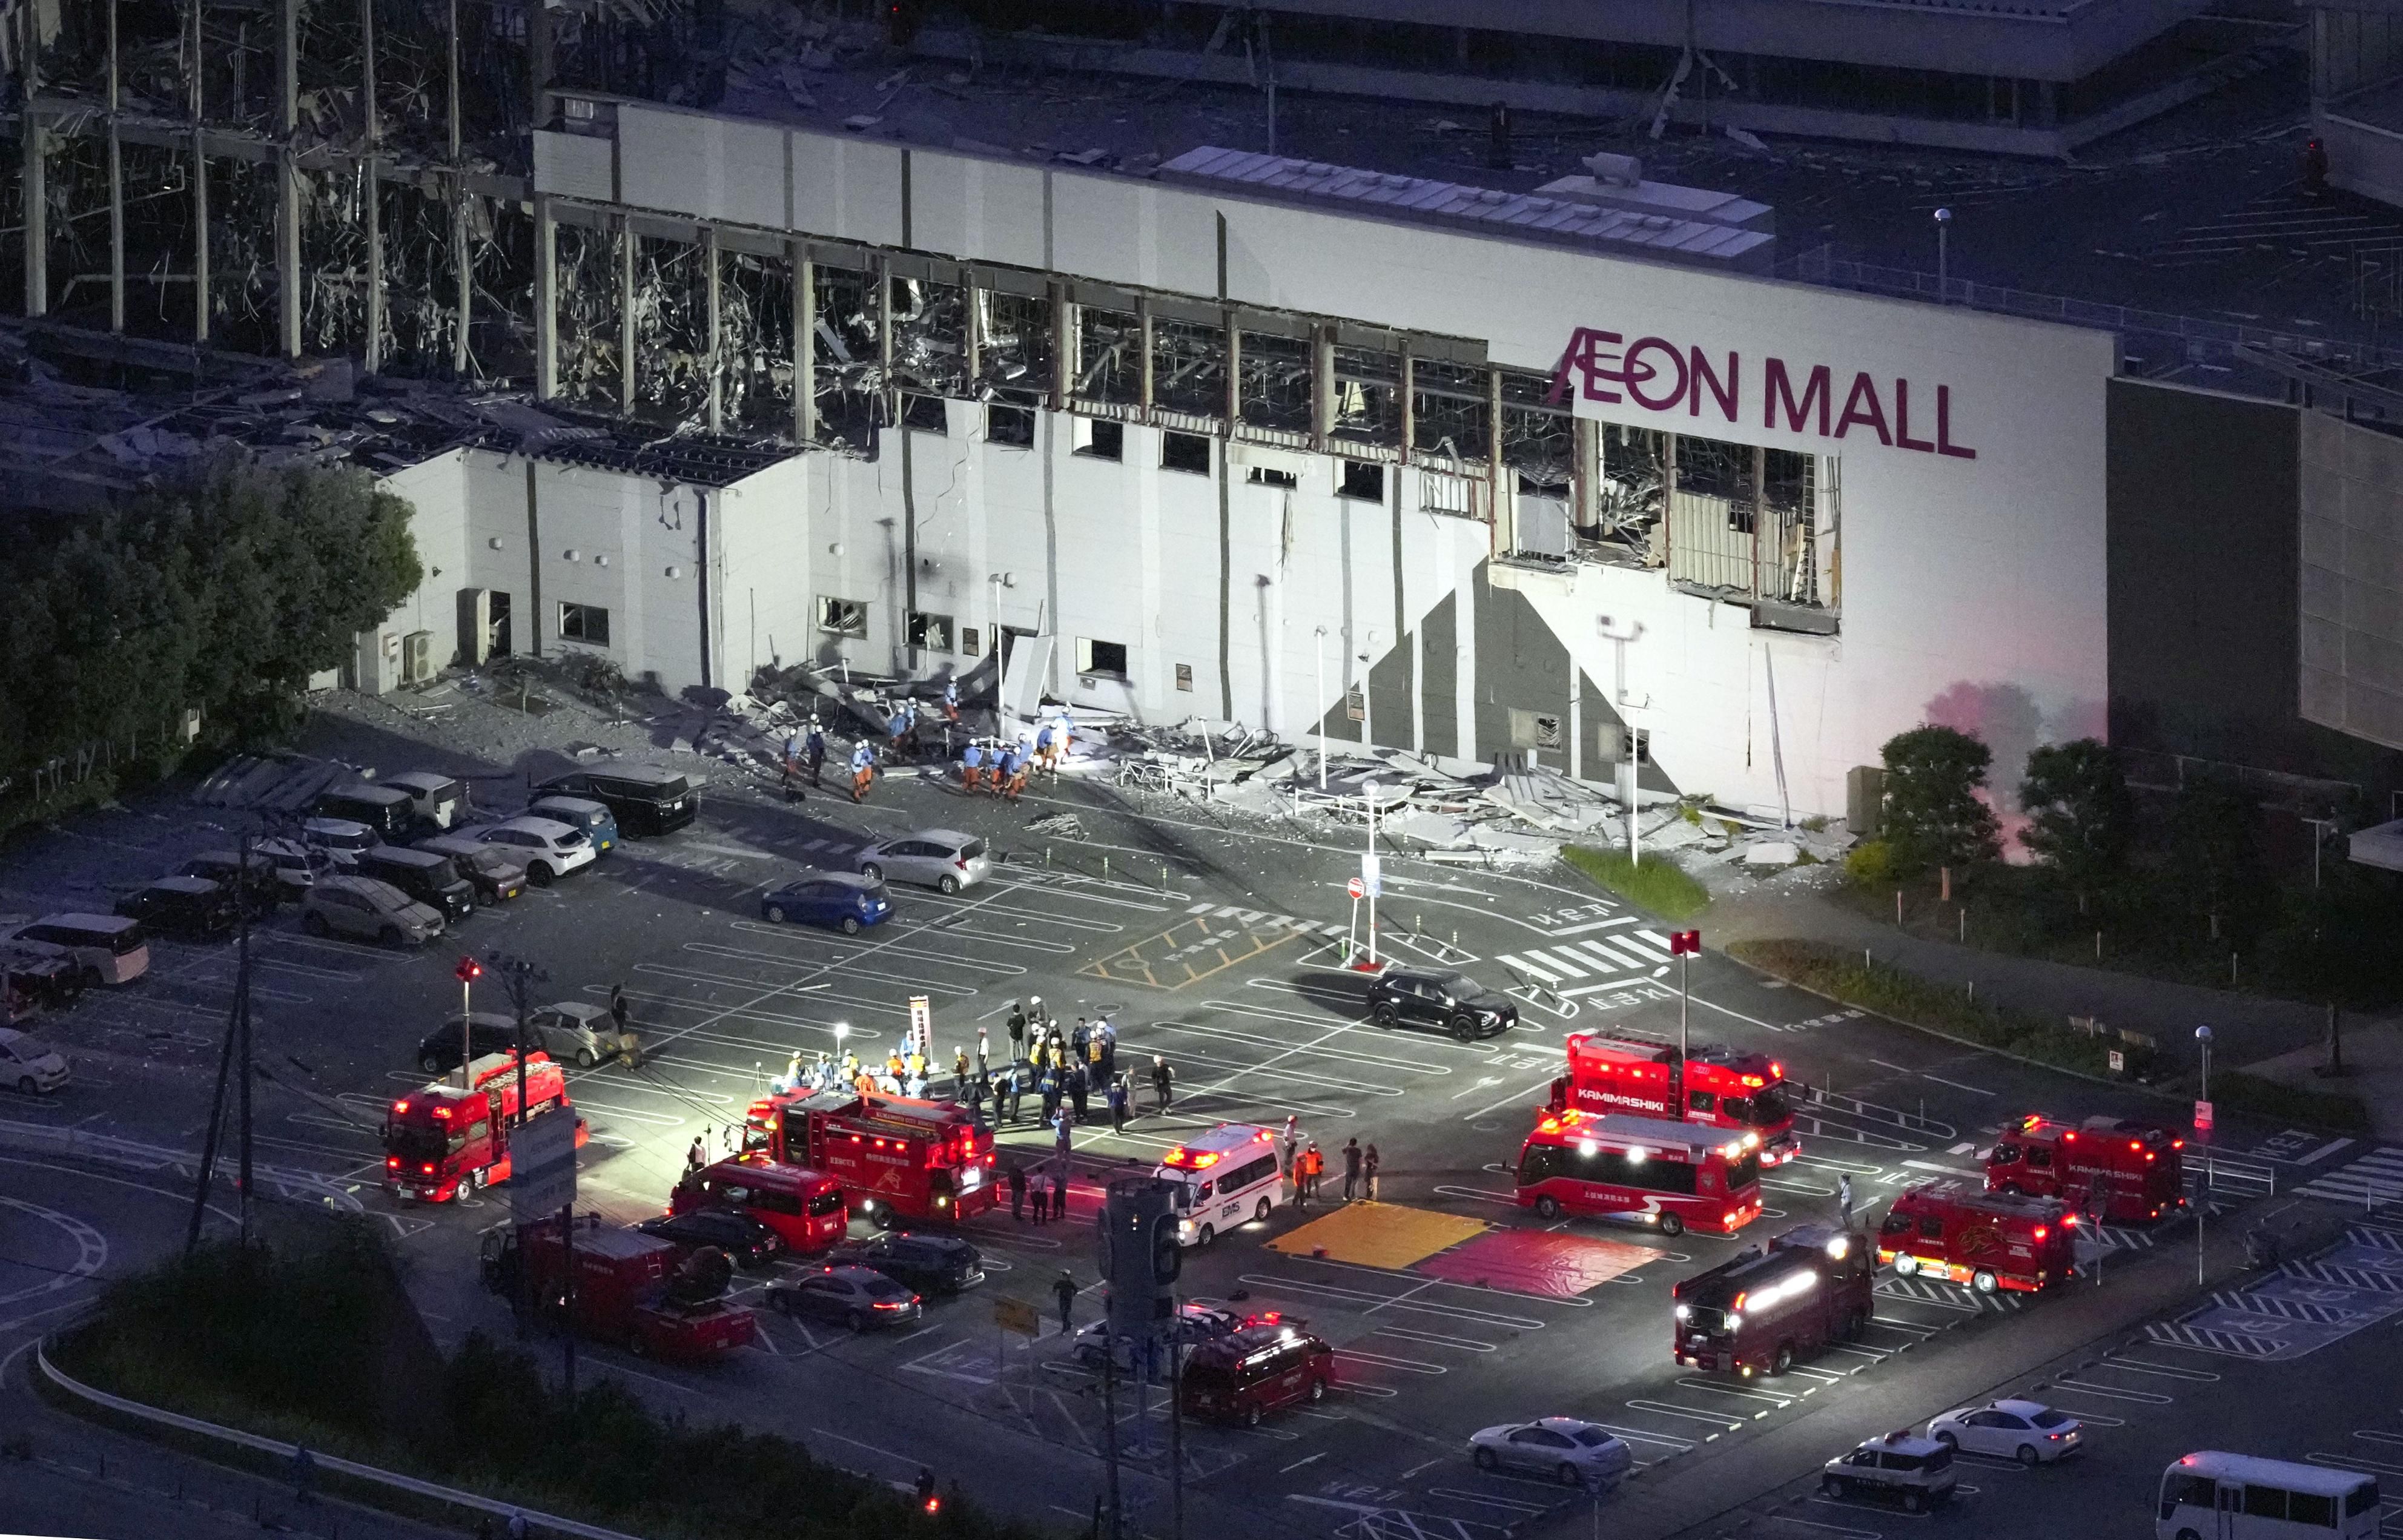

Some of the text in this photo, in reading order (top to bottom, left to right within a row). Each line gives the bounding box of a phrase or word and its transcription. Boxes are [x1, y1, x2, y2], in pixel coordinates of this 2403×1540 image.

[1765, 357, 1976, 459] MALL
[1527, 904, 1611, 925] 止まれ
[1587, 988, 1671, 1011] 止まれ
[1578, 1088, 1664, 1112] KAMIMASHIKI
[1222, 1201, 1240, 1218] EMS
